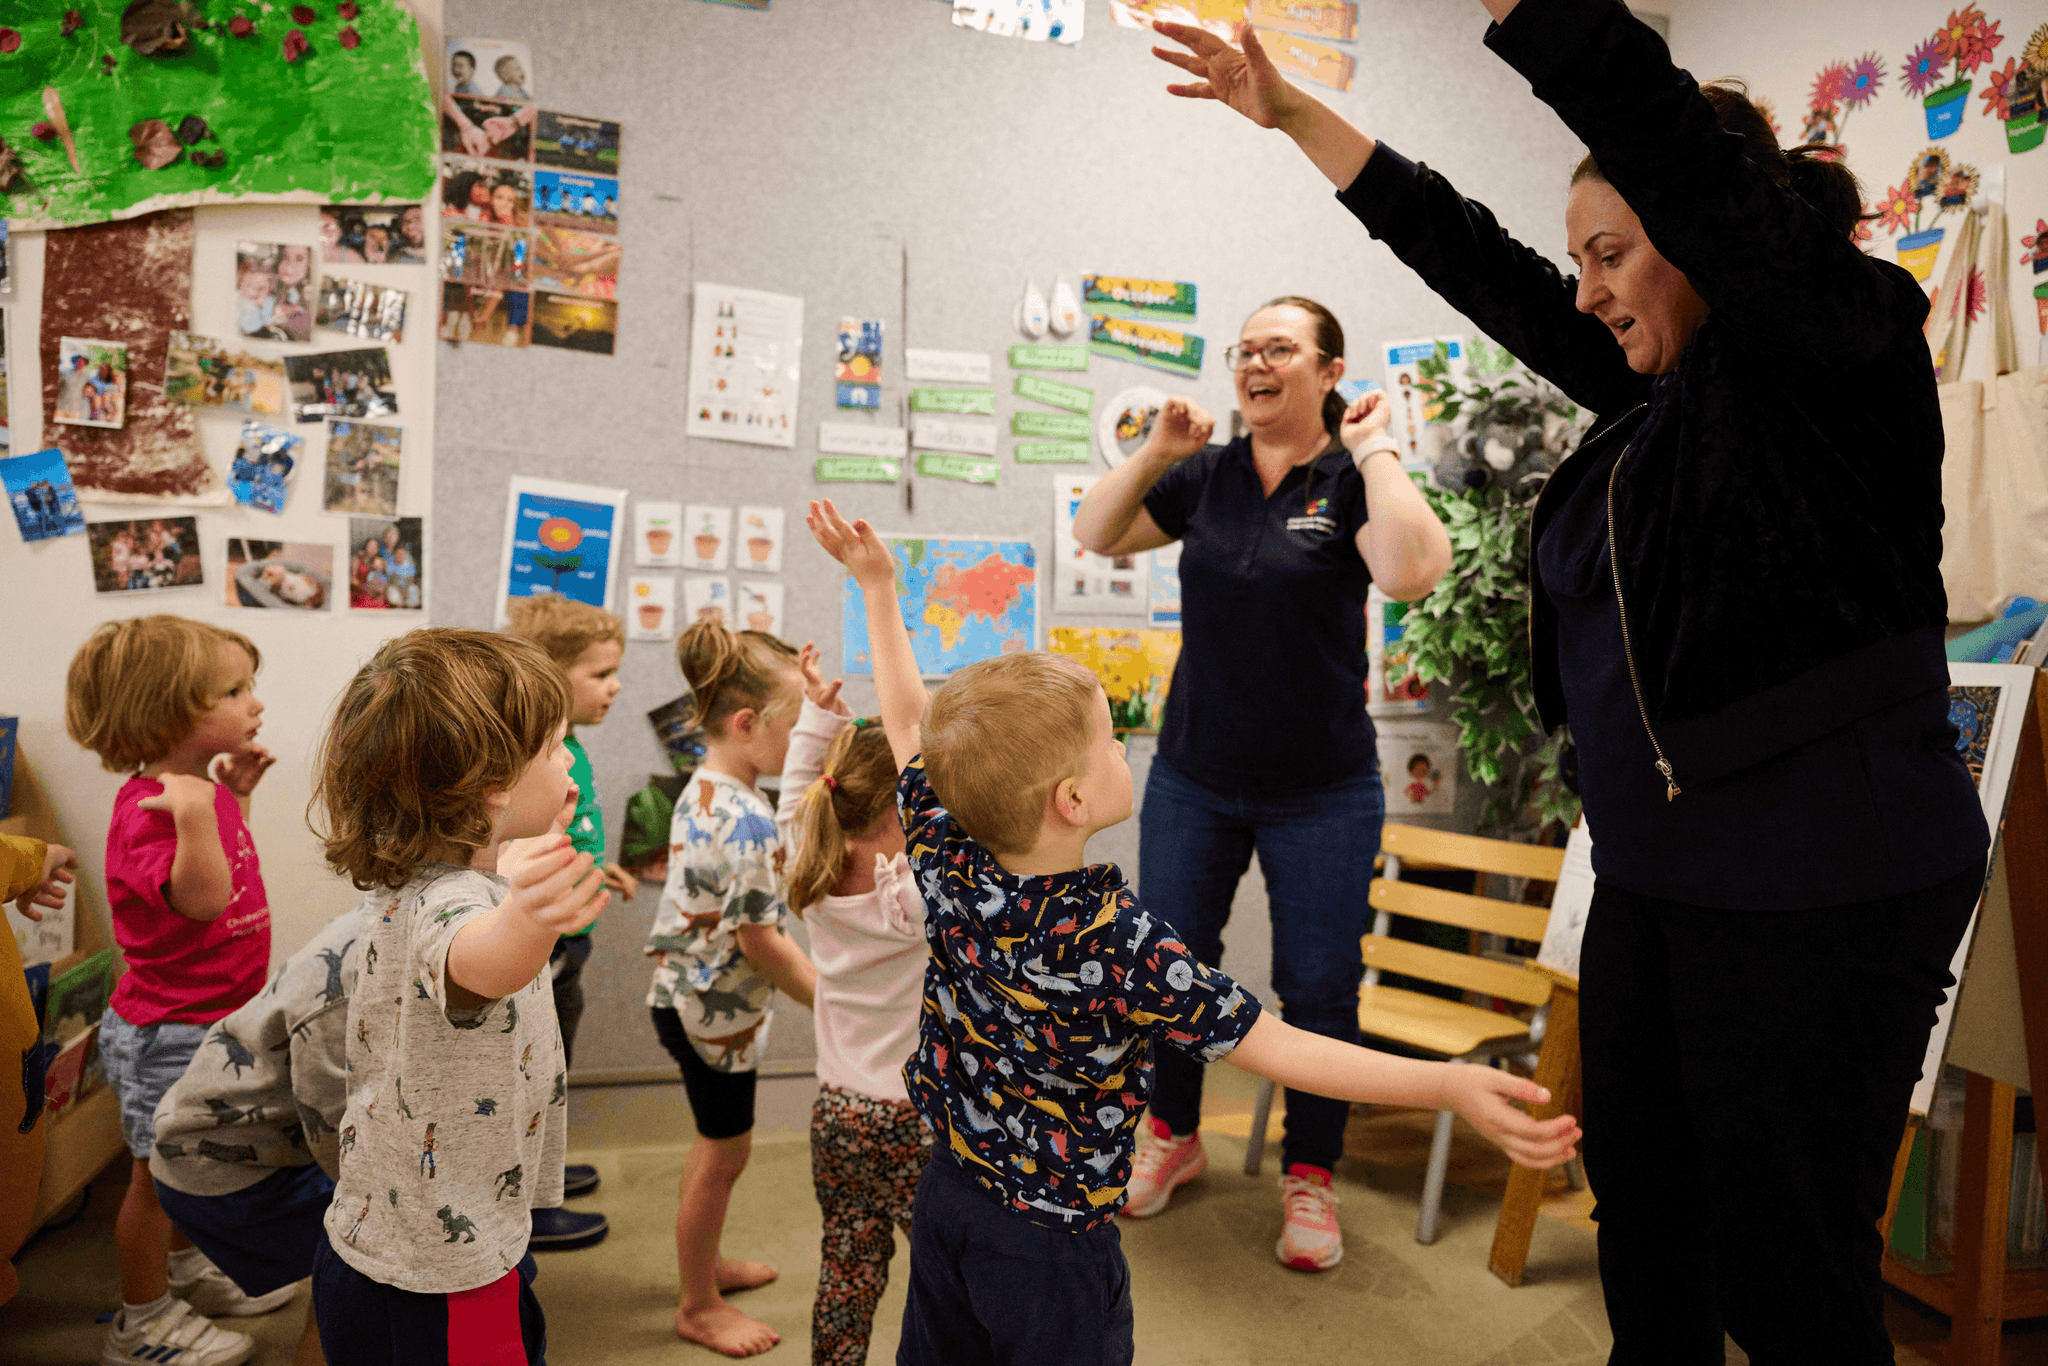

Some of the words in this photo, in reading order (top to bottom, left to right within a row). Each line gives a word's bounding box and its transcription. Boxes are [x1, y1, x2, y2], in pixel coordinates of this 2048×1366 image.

[1289, 46, 1318, 68] May
[1111, 286, 1170, 305] October
[1111, 328, 1184, 356] November
